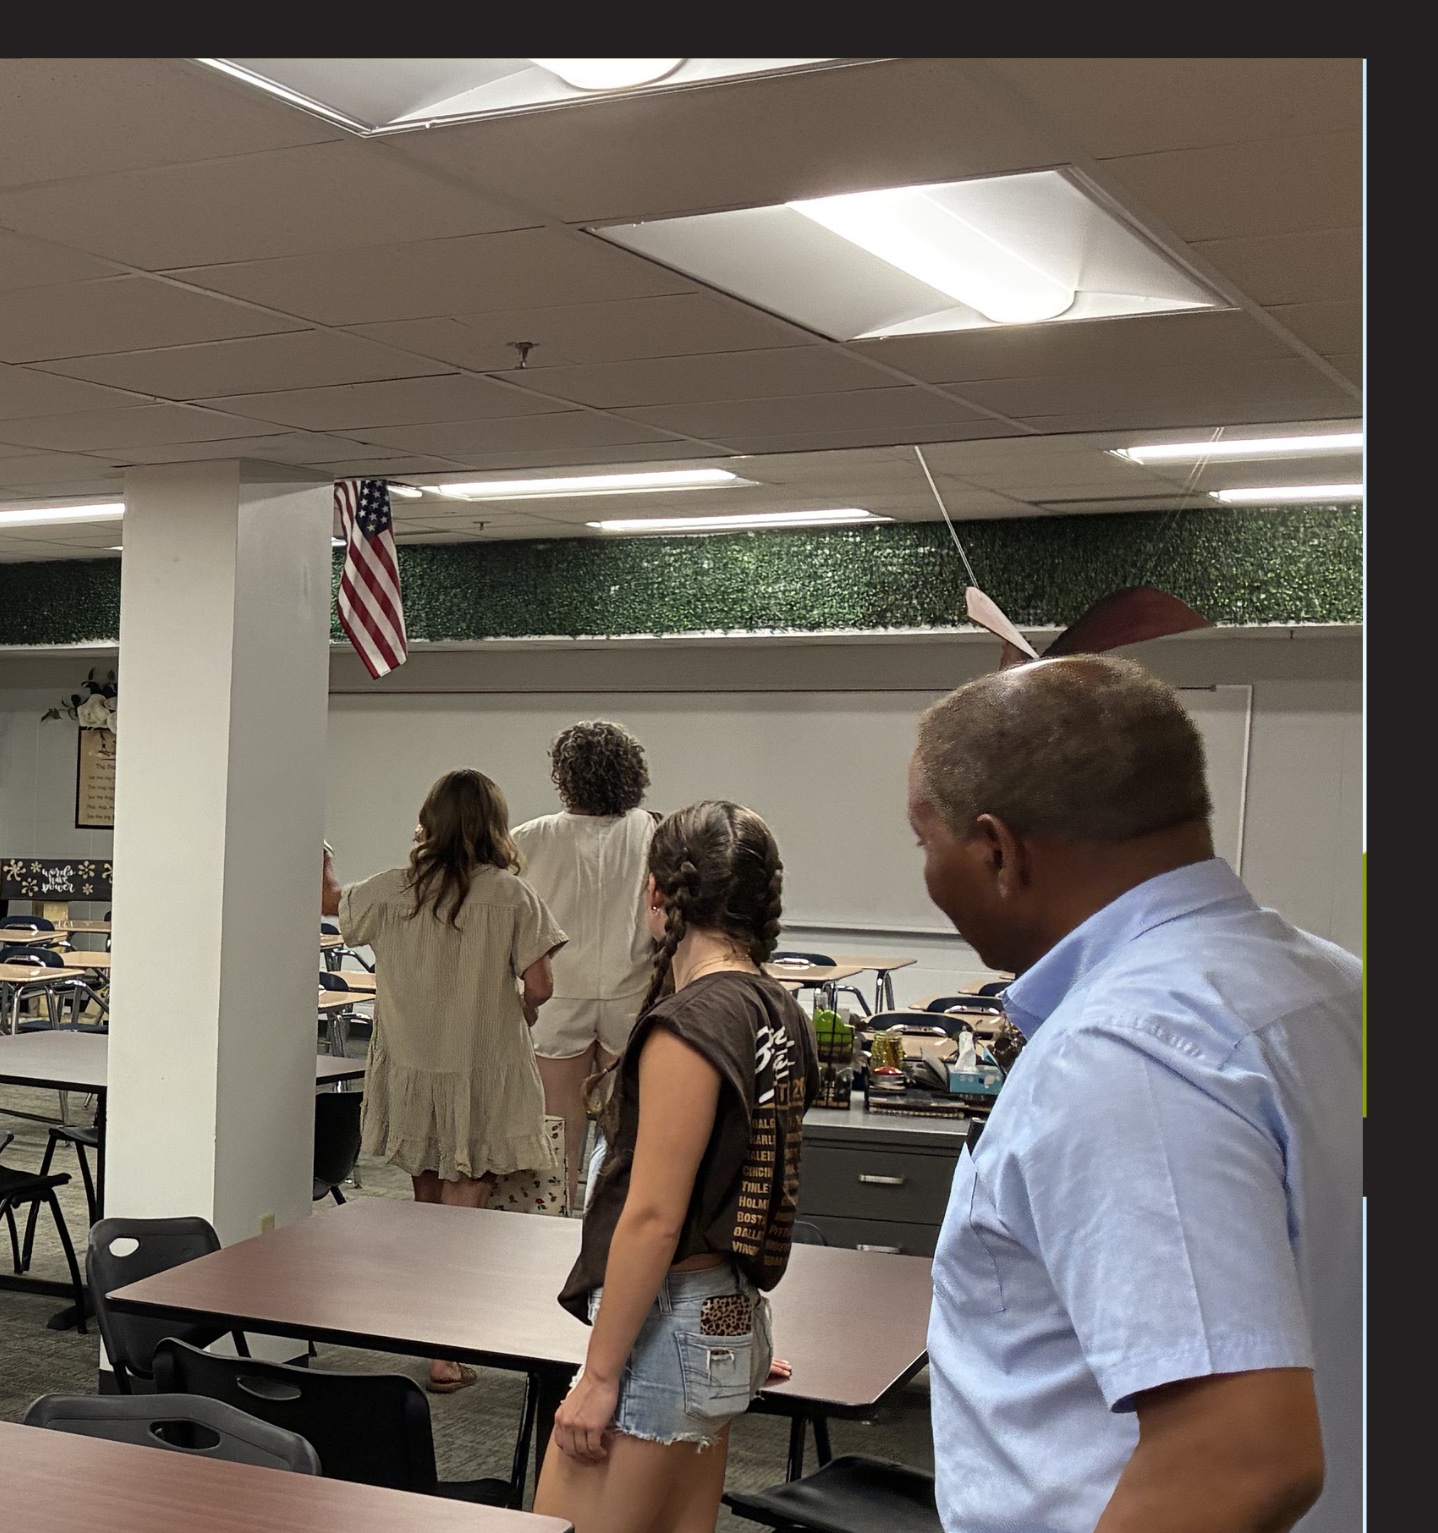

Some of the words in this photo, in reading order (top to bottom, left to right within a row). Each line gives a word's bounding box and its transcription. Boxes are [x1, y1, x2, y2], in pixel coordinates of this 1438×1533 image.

[42, 865, 74, 876] words
[41, 882, 75, 894] power
[742, 1181, 772, 1194] TINLE
